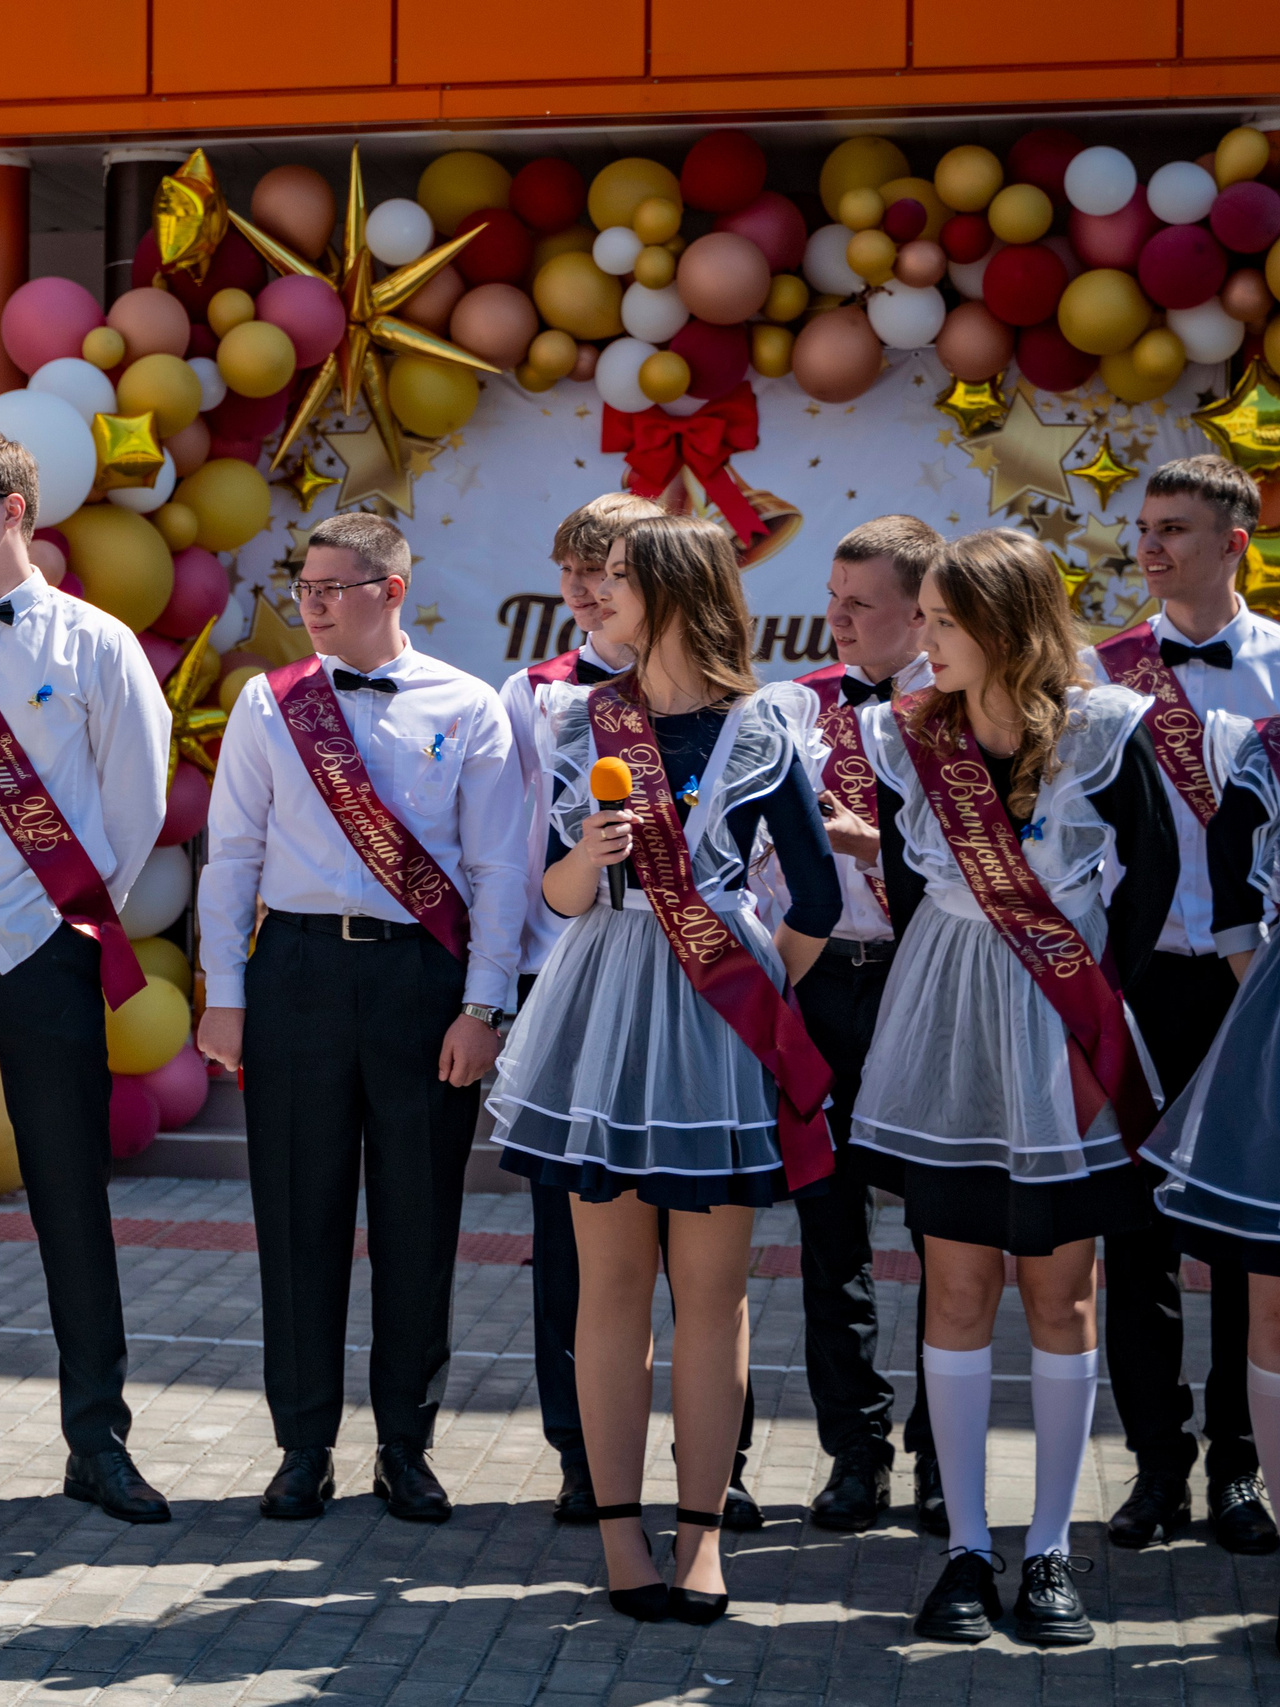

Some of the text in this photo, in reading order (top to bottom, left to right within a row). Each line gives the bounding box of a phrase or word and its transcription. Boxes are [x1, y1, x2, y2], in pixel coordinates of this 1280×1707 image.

[8, 793, 71, 853] 2025
[312, 767, 322, 777] 11
[339, 815, 368, 847] МБОУ
[314, 736, 451, 909] Выпускник 2025
[930, 790, 942, 801] 11
[932, 802, 951, 830] класс
[940, 760, 1094, 979] Выпускница 2025
[959, 852, 987, 891] МБОУ
[670, 902, 739, 964] 2025
